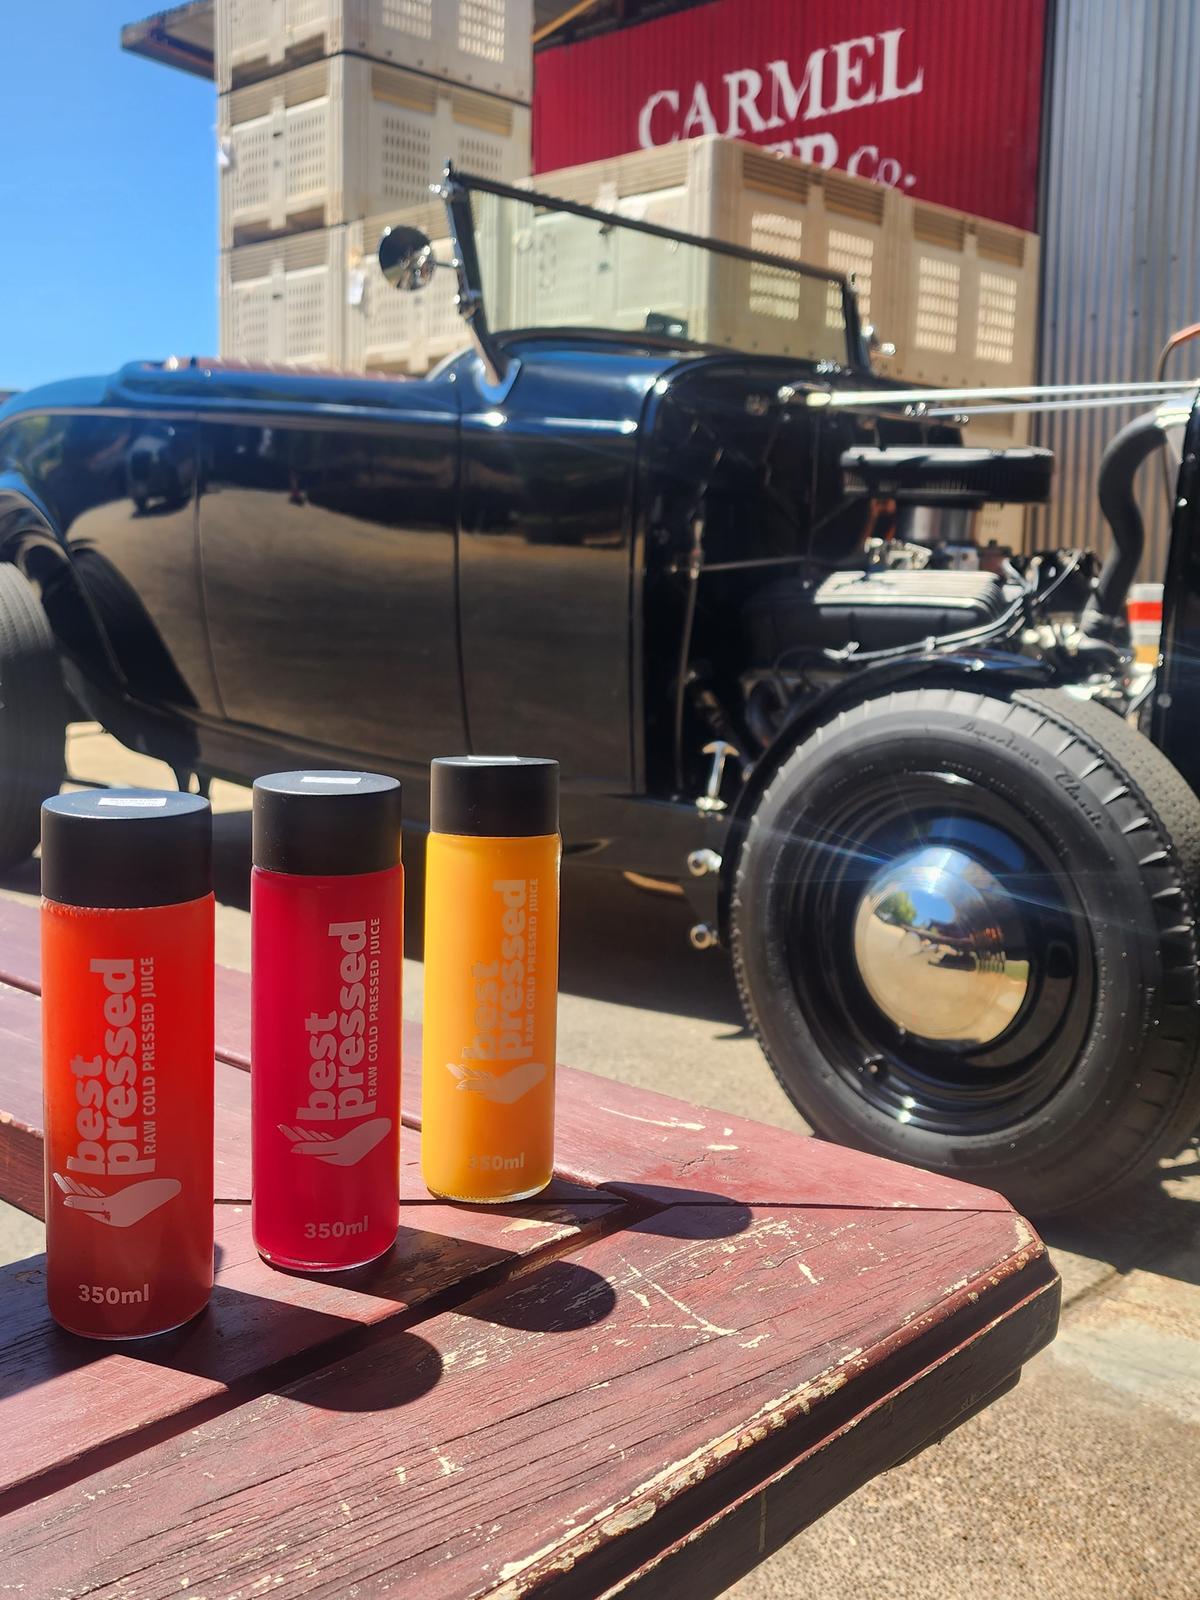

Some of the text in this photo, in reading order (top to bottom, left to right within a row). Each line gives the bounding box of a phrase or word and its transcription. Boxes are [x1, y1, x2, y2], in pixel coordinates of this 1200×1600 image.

[638, 28, 924, 151] CARMEL
[328, 919, 378, 1120] pressed
[368, 917, 381, 1098] RAW COLD PRESSED JUICE
[461, 958, 500, 1061] best
[492, 879, 534, 1061] pressed
[525, 878, 539, 1042] RAW COLD PRESSED JUICE
[66, 1053, 105, 1175] best
[90, 958, 157, 1177] pressed
[140, 956, 158, 1155] RAW COLD PRESSED JUICE
[295, 1010, 338, 1121] best
[469, 1152, 525, 1171] 350ml
[304, 1216, 370, 1239] 350ml
[77, 1284, 150, 1306] 350ml
